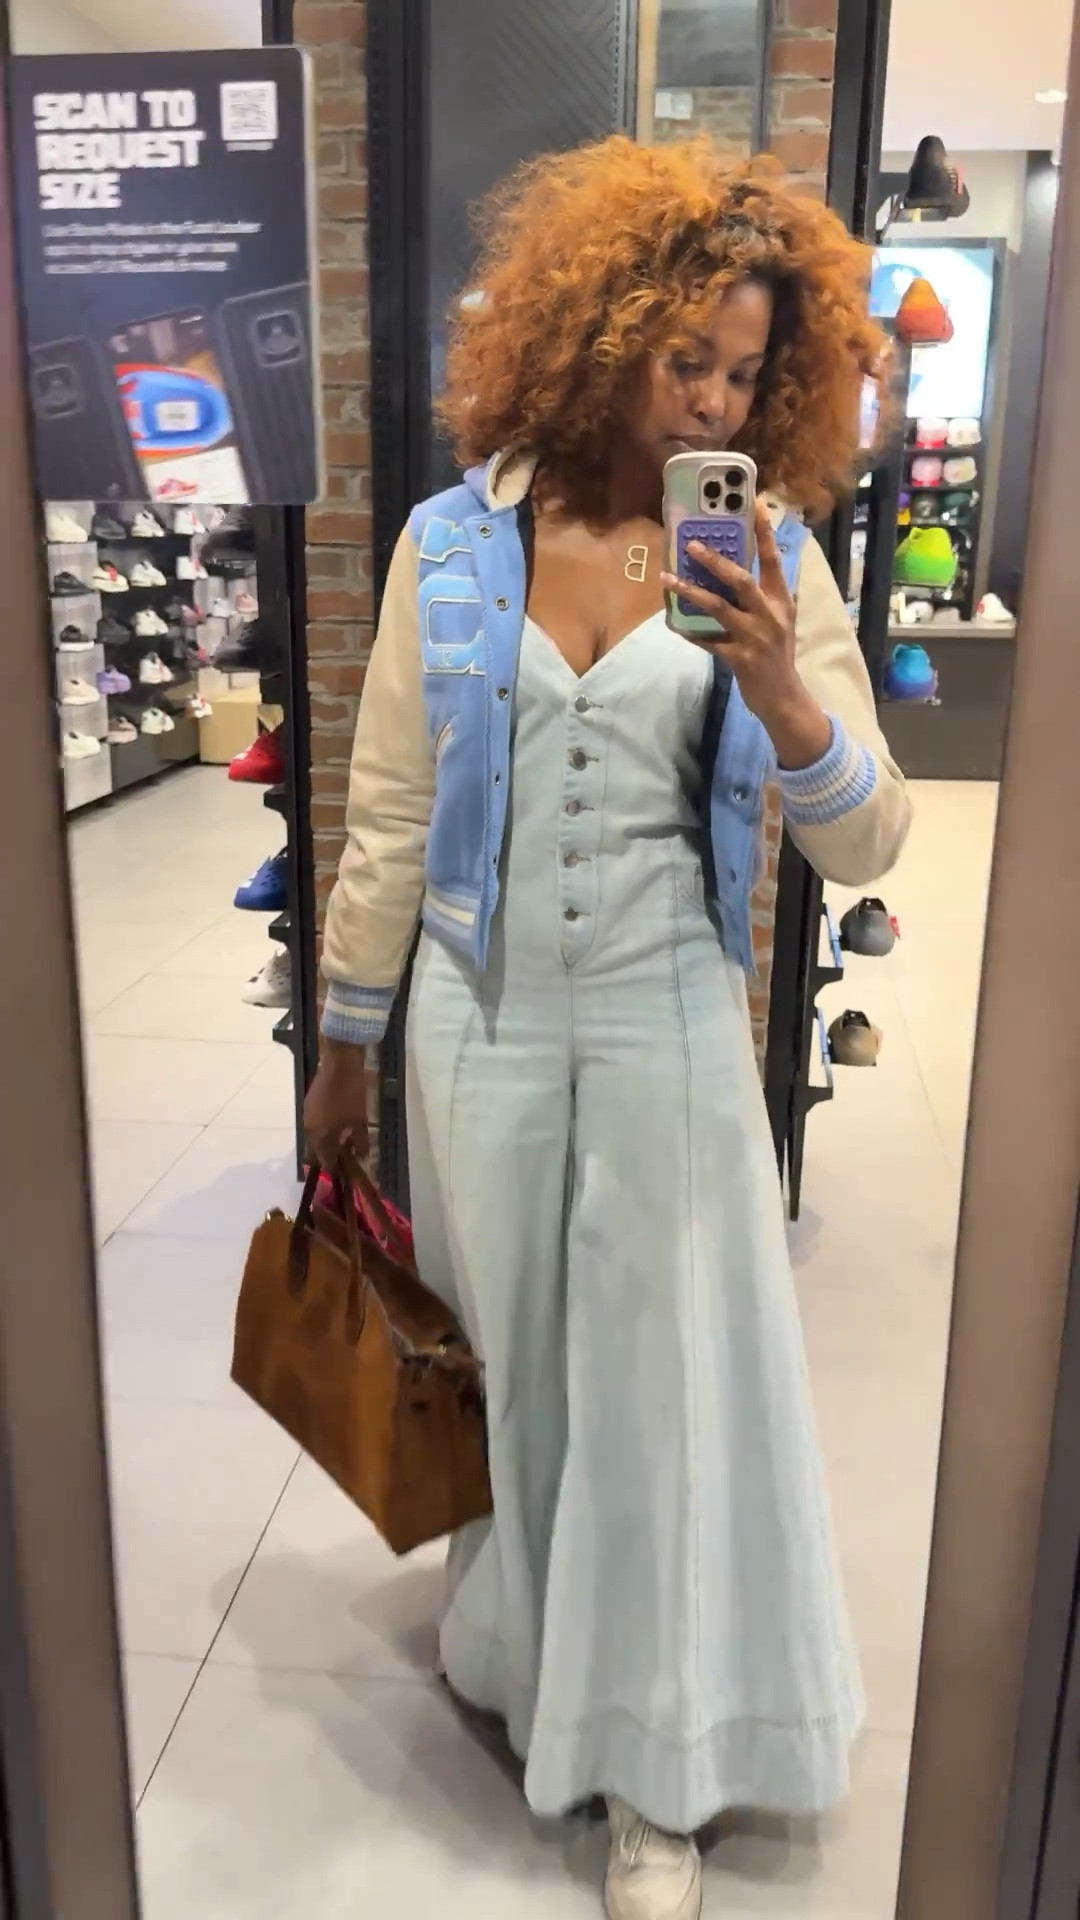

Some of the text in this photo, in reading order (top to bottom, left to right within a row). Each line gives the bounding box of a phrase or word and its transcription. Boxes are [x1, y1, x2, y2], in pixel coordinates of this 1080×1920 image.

[33, 90, 196, 130] SCAN TO
[35, 131, 206, 170] REQUEST
[39, 172, 121, 209] SIZE
